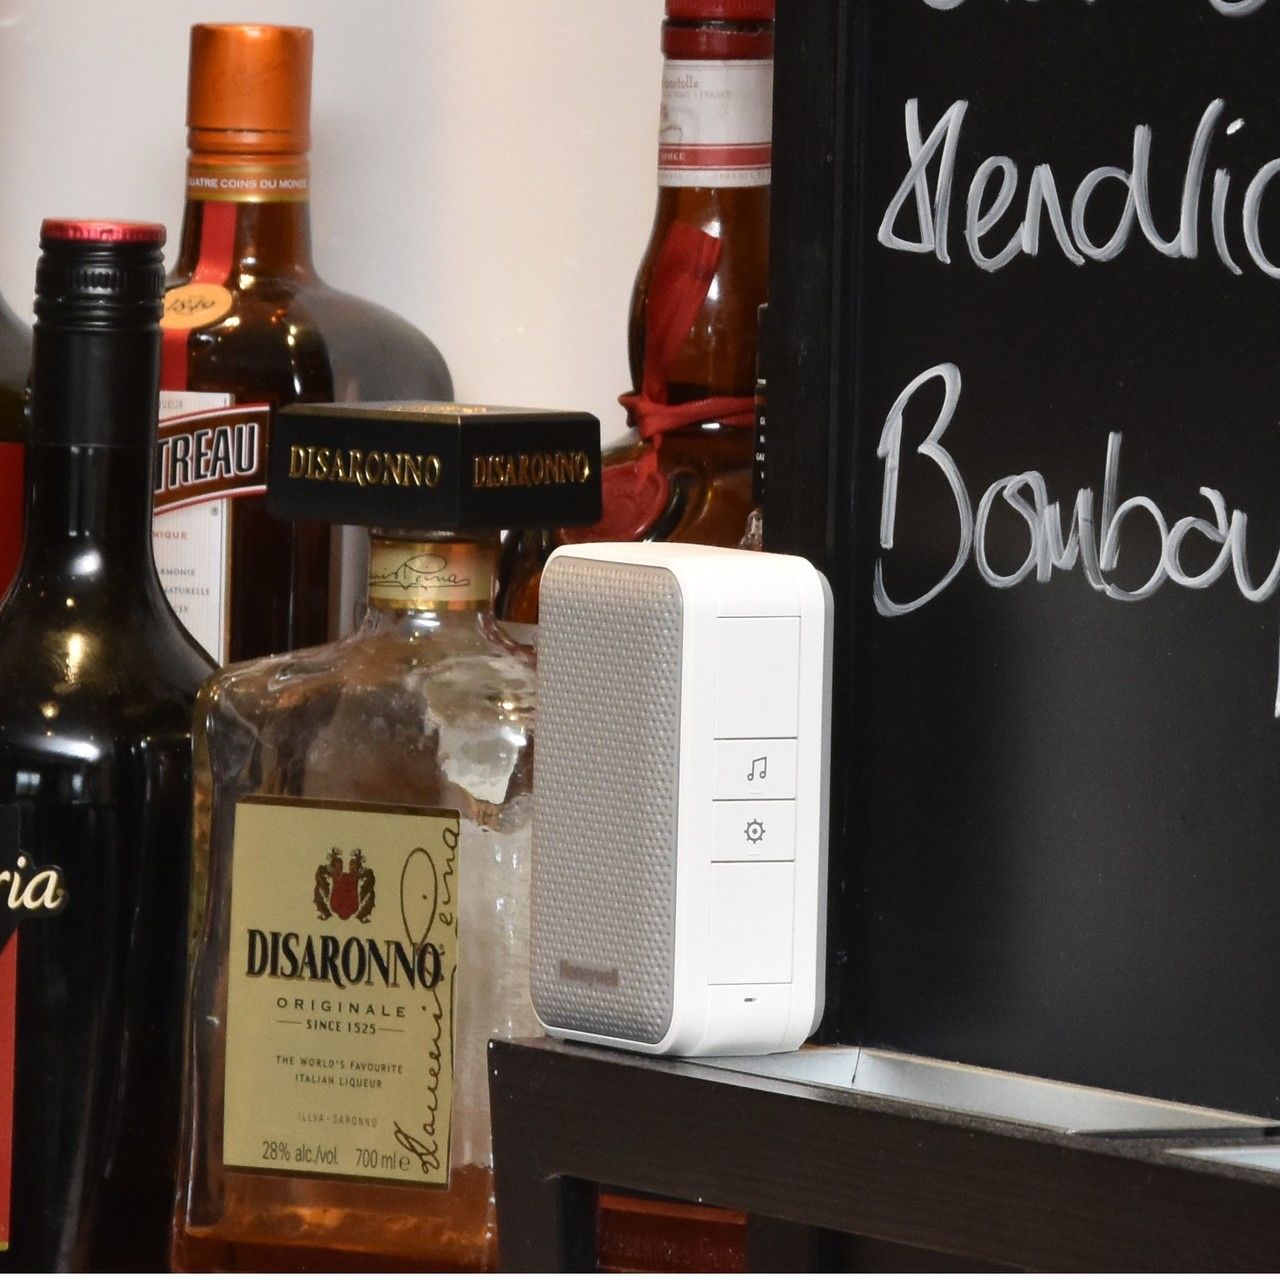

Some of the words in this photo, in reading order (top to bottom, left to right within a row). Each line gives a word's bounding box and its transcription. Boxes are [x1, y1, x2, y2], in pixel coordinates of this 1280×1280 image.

[220, 178, 257, 188] COINS
[259, 178, 276, 188] DU
[155, 421, 261, 494] TREAU
[289, 444, 442, 489] DISARONNO
[473, 449, 592, 489] DISARONNO
[245, 927, 443, 991] DISARONNO
[276, 995, 407, 1019] ORIGINALE
[305, 1018, 342, 1034] SINCE
[346, 1020, 377, 1036] 1525
[275, 1055, 295, 1066] THE
[299, 1056, 345, 1070] WORLD'S
[349, 1060, 403, 1075] FAVOURITE
[294, 1073, 335, 1085] ITALIAN
[339, 1076, 382, 1090] LIQUEUR
[332, 1115, 378, 1129] SARONNO
[262, 1140, 291, 1162] 28%
[356, 1147, 378, 1168] 700
[381, 1150, 397, 1169] ml
